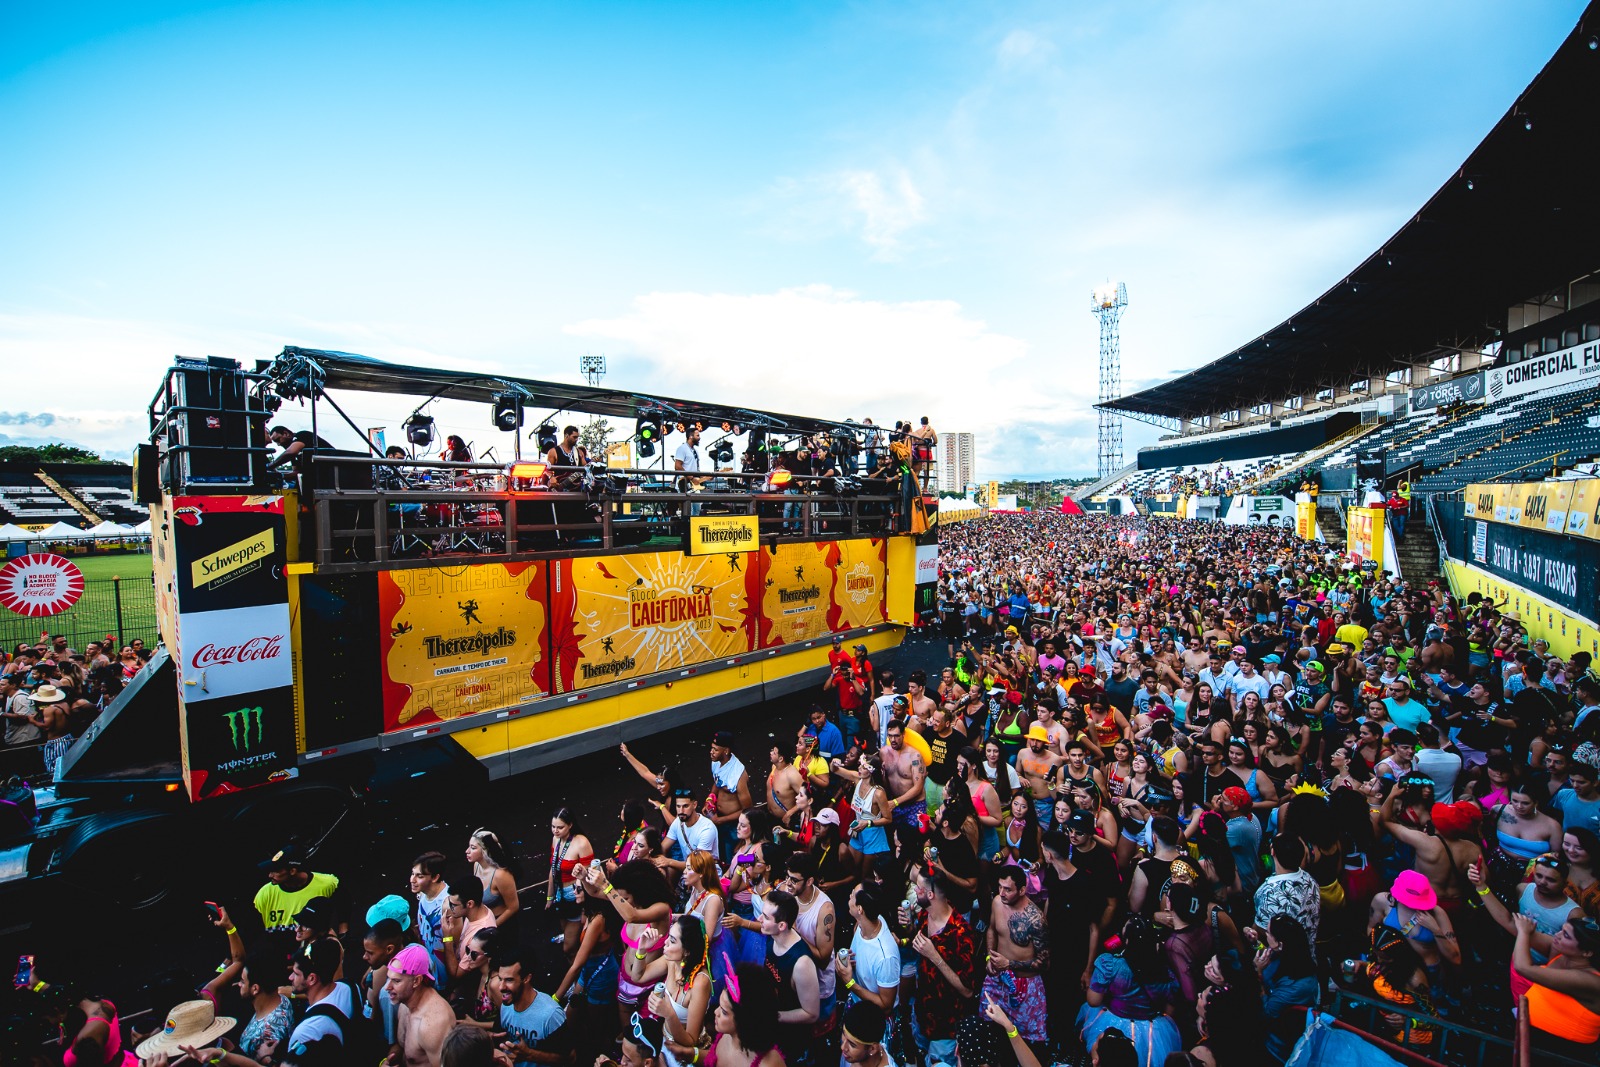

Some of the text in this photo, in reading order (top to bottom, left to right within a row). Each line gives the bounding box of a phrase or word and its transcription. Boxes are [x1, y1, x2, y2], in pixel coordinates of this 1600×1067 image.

[1506, 352, 1577, 385] COMERCIAL
[1430, 385, 1460, 400] TORCE
[1478, 493, 1494, 515] CAIXA
[1525, 495, 1548, 522] CAIXA
[697, 523, 752, 546] Therezópolis
[202, 541, 265, 576] Schweppes
[1493, 542, 1511, 571] SETOR
[1513, 549, 1518, 574] A
[1522, 552, 1541, 583] 3.897
[1544, 558, 1577, 598] PESSOAS
[23, 588, 56, 597] Coca-Cola
[631, 589, 656, 603] BLOCO
[778, 584, 820, 603] Therezópolis
[631, 595, 712, 628] CALIFÓRNIA
[192, 634, 285, 669] Coca-Cola
[422, 627, 517, 660] Therezópolis
[436, 666, 463, 676] CARNAVAL
[467, 662, 484, 670] TEMPO
[580, 655, 636, 680] Therezópolis
[217, 751, 278, 772] MONSTER
[269, 909, 285, 923] 87
